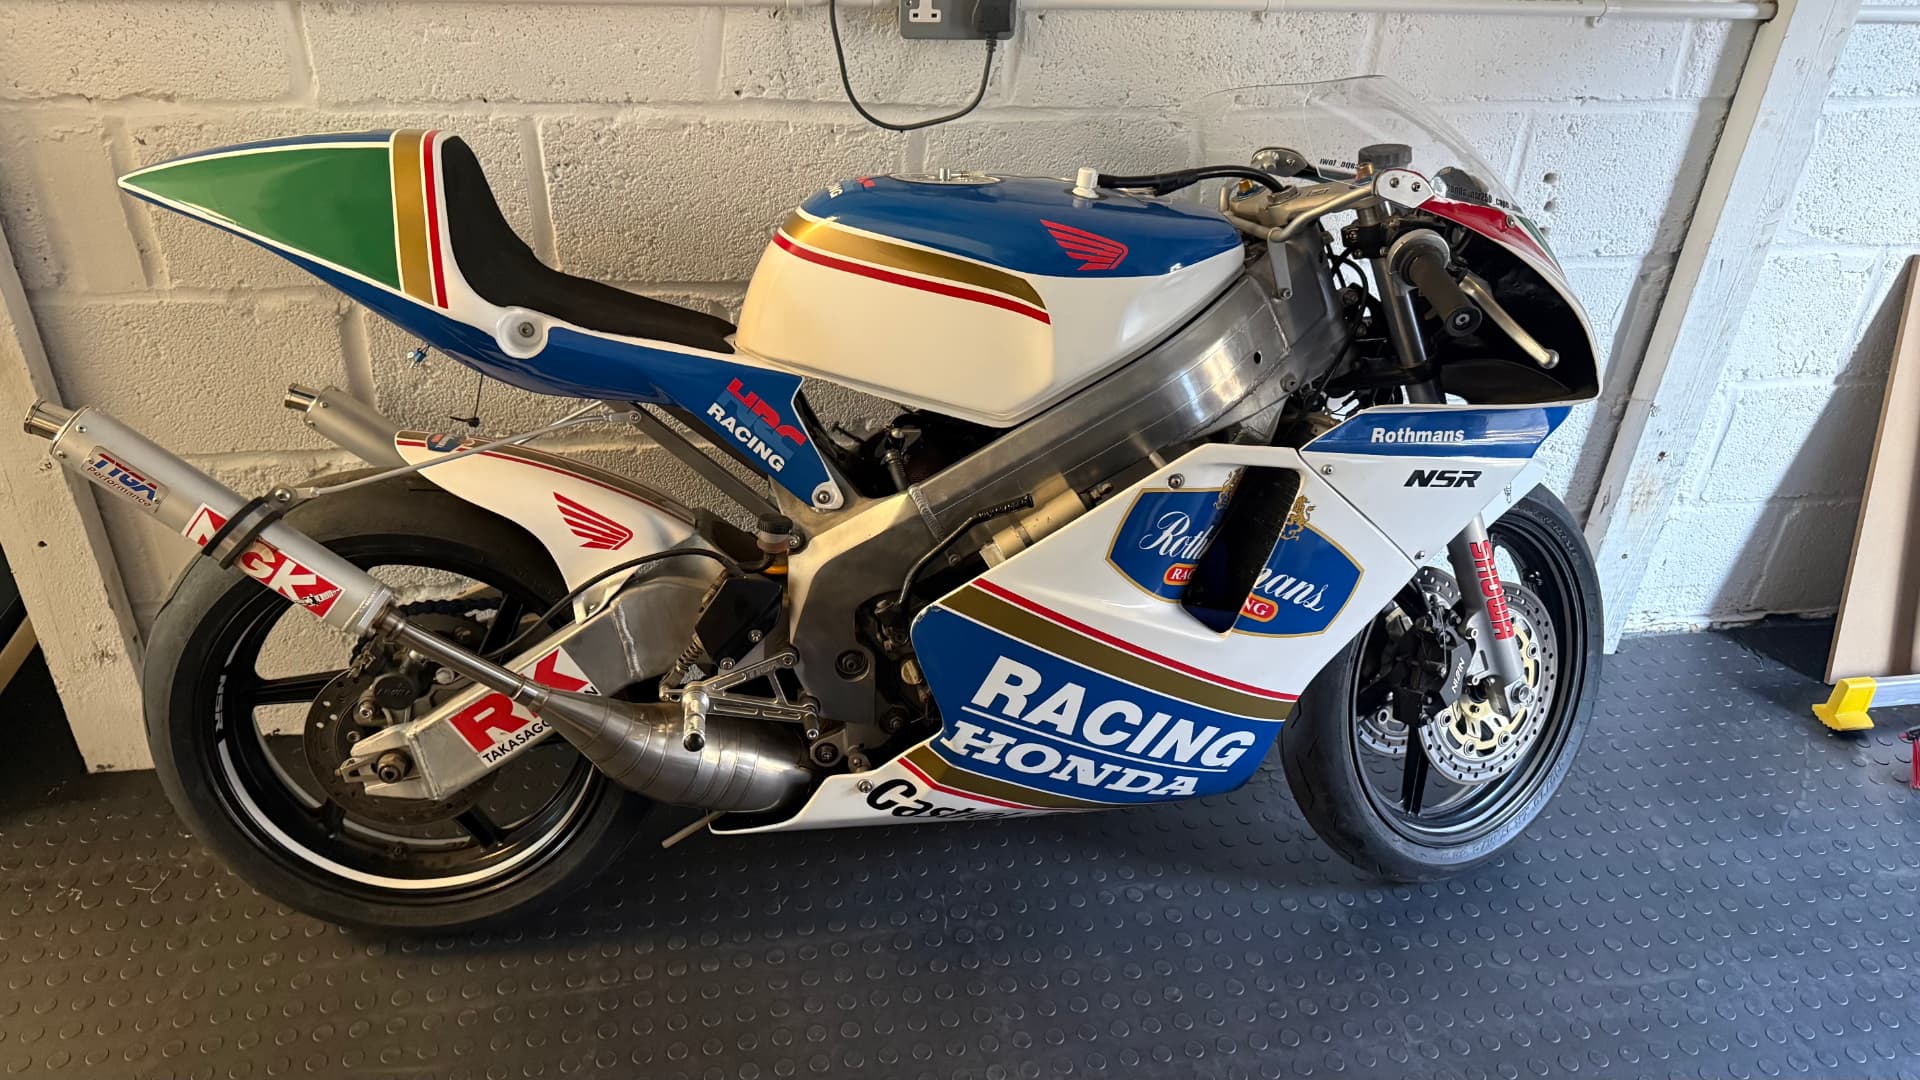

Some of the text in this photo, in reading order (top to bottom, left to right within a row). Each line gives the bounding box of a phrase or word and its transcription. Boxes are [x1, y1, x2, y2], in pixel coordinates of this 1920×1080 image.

[706, 402, 785, 472] RACING
[1371, 427, 1465, 443] Rothmans
[87, 465, 152, 508] Performance
[1403, 469, 1482, 488] NSR
[1469, 540, 1515, 641] SHOWA
[971, 655, 1256, 767] RACING
[940, 720, 1199, 796] HONDA
